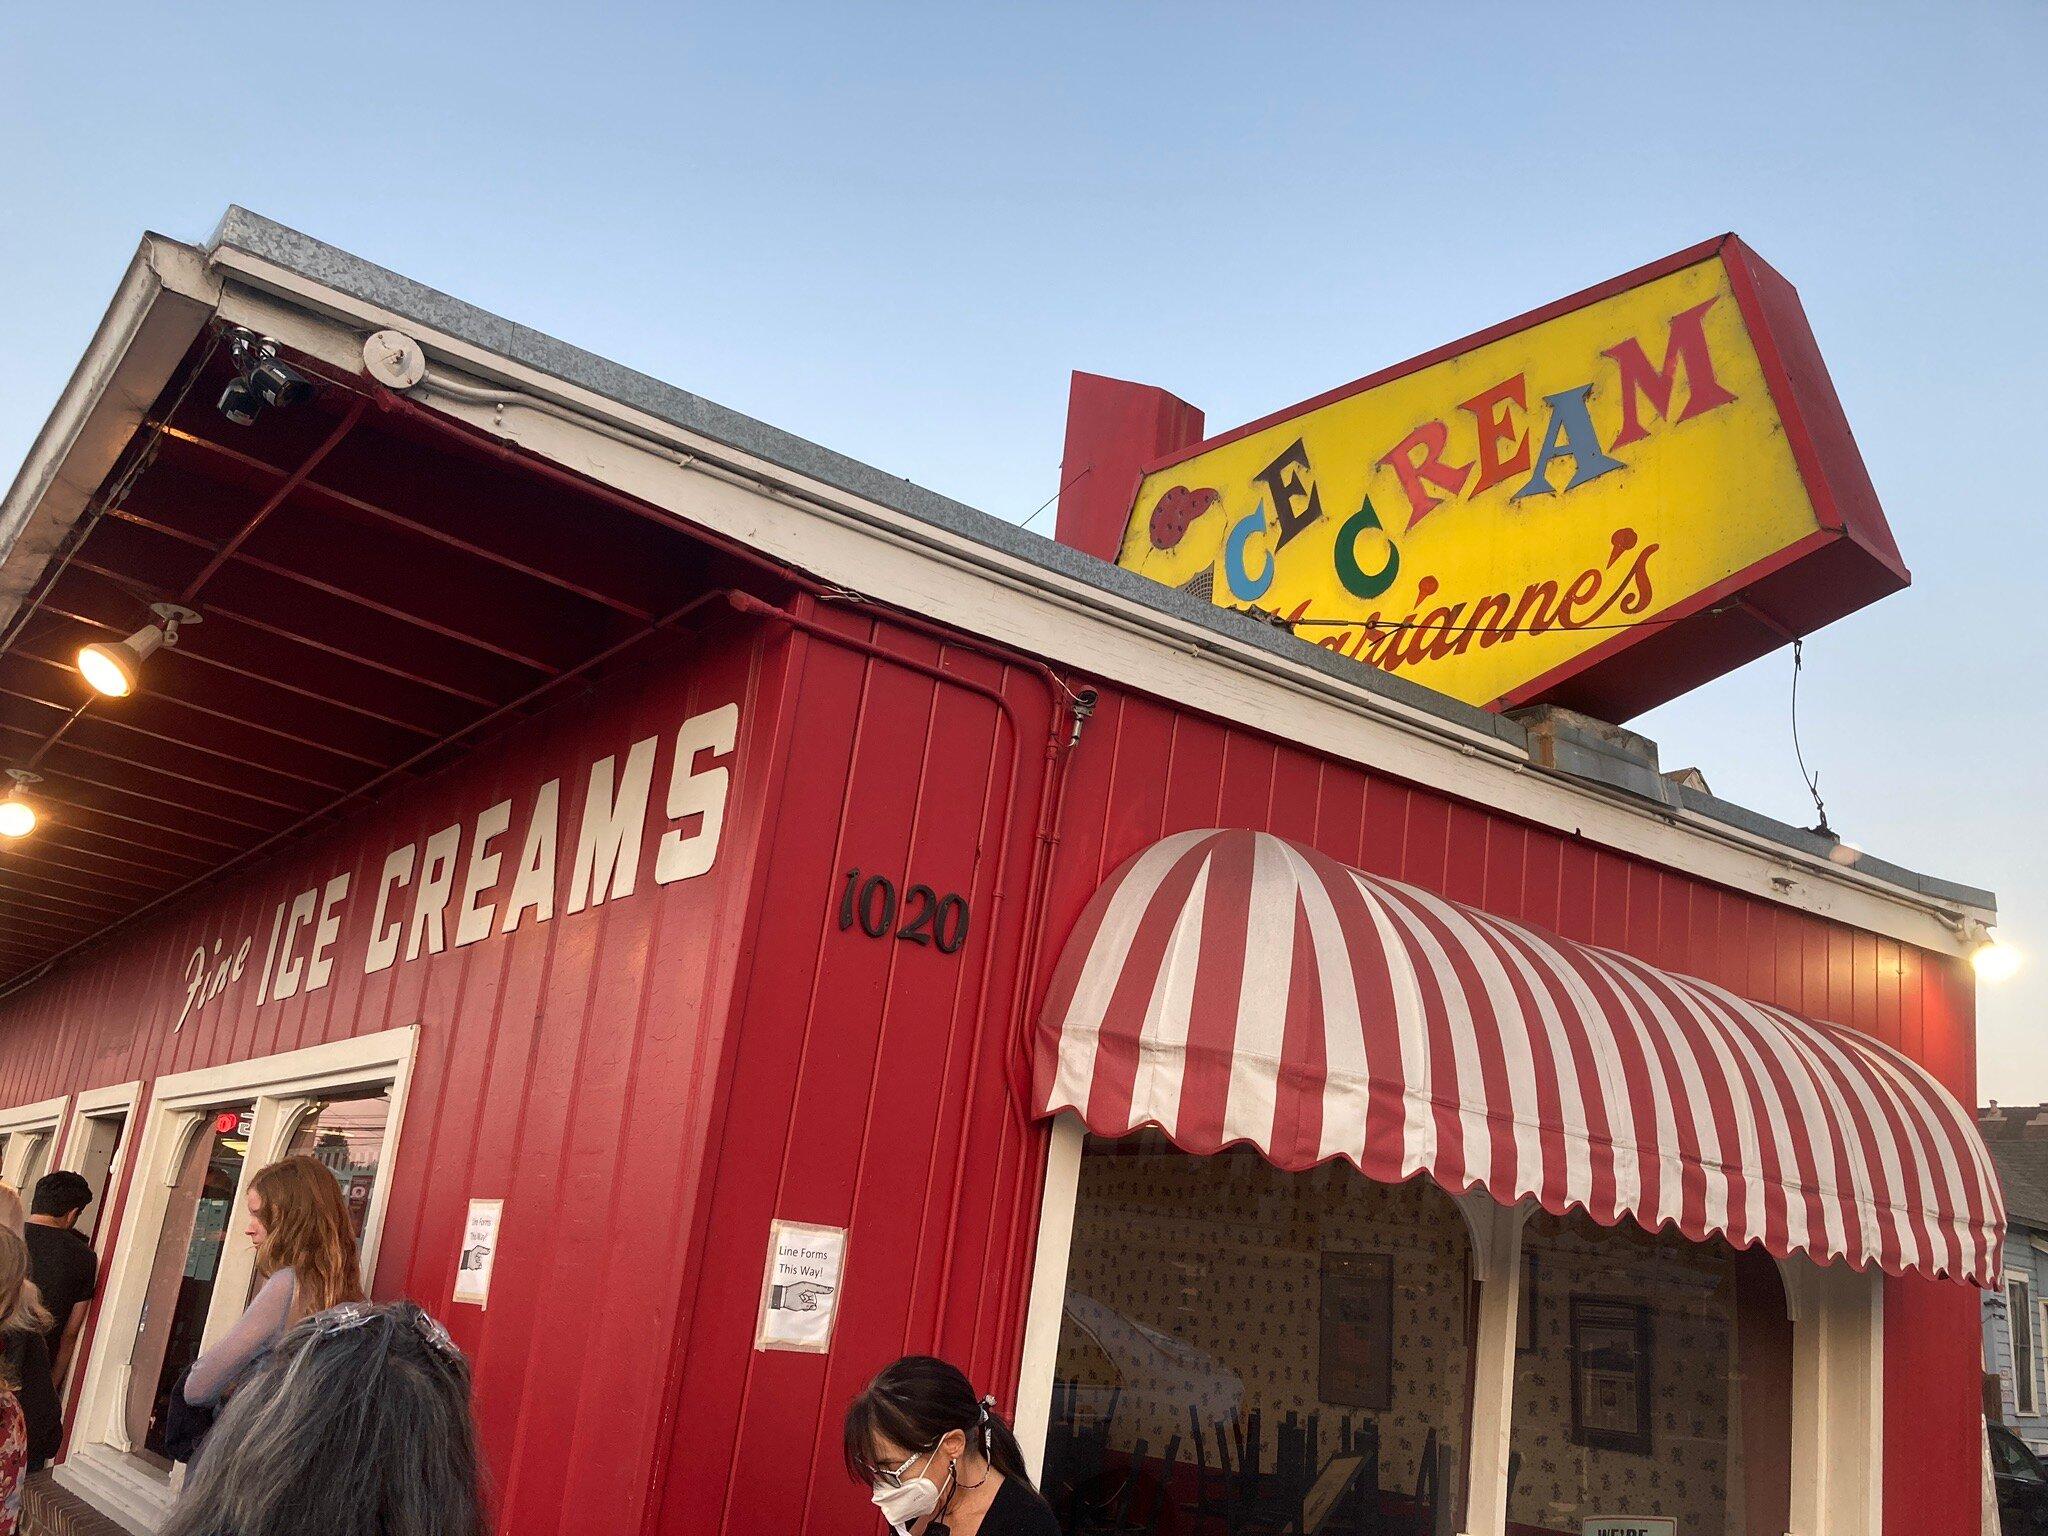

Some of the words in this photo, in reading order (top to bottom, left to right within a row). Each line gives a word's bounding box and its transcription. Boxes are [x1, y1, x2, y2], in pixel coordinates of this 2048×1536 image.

[1334, 296, 1739, 600] CREAM
[1272, 526, 1660, 672] arianne's
[174, 935, 252, 1034] Fine
[256, 873, 350, 1007] ICE
[364, 702, 739, 975] CREAMS
[839, 867, 970, 954] 1020
[779, 1245, 799, 1257] Line
[801, 1247, 828, 1260] Forms
[779, 1263, 798, 1275] This
[800, 1265, 824, 1279] Way!
